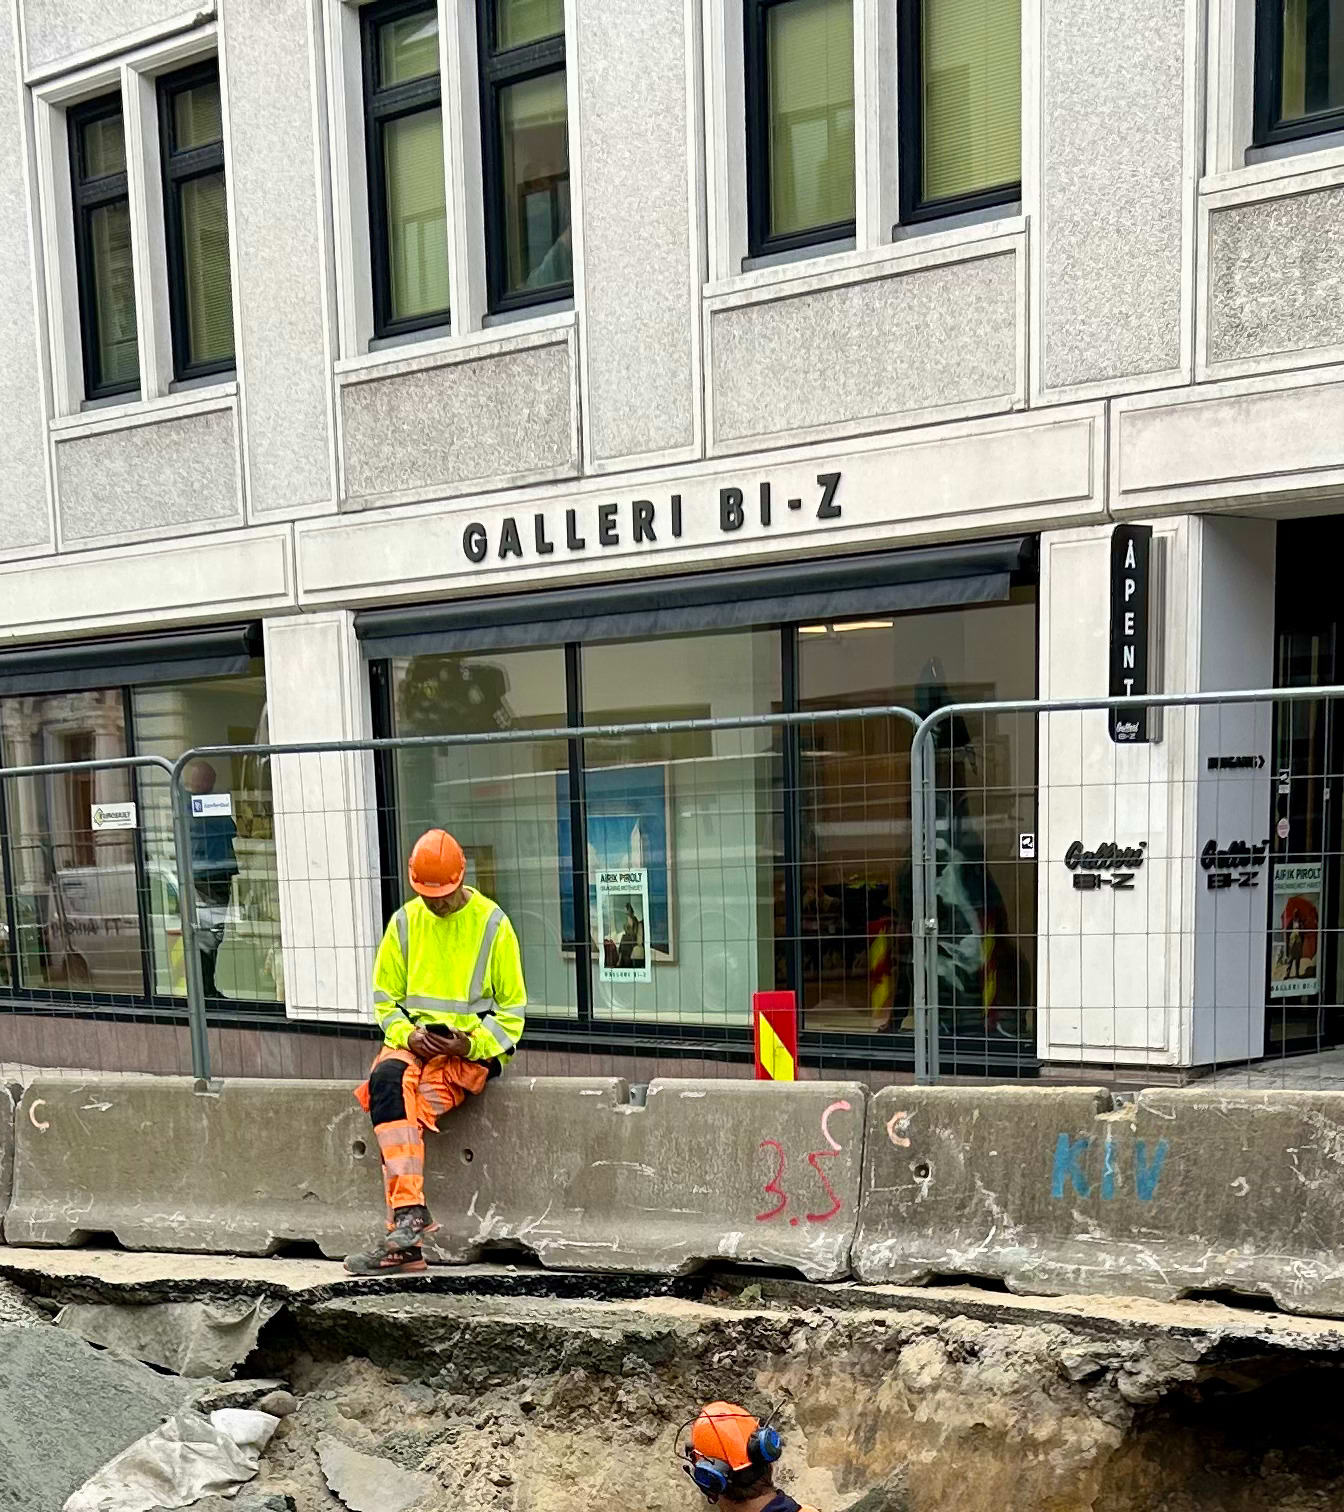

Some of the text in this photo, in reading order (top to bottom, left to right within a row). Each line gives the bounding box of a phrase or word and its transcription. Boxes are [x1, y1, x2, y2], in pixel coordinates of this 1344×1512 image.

[462, 472, 843, 562] GALLERI BI-Z
[1123, 539, 1136, 697] ÅPENT
